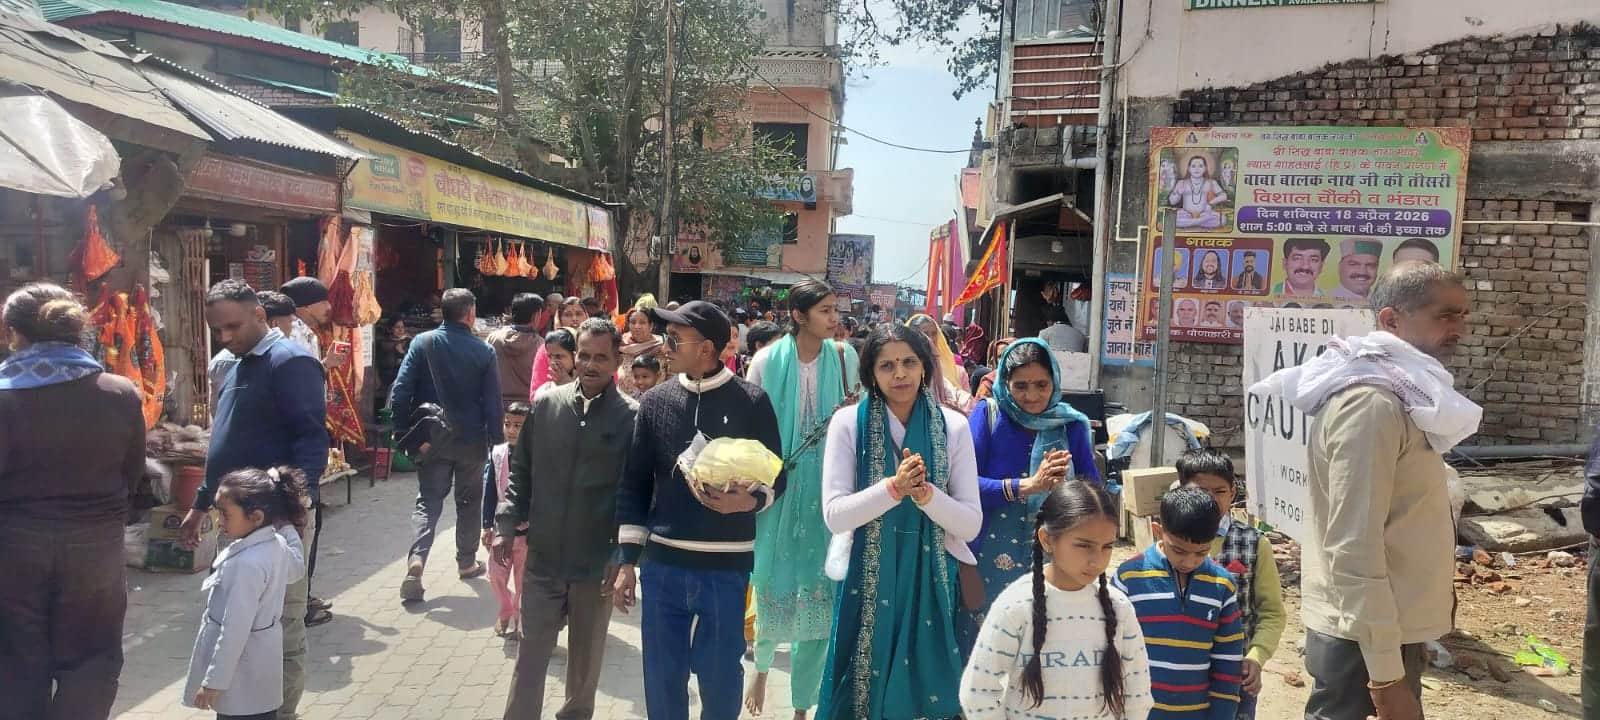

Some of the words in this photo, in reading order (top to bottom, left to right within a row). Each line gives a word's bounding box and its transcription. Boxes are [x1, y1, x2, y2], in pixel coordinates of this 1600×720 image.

[1279, 174, 1324, 187] बालक
[1359, 172, 1379, 187] जी
[1408, 172, 1452, 188] तीसरी
[1253, 188, 1311, 204] विशाल
[1367, 193, 1381, 205] व
[1386, 190, 1441, 207] भंडारा
[1256, 207, 1280, 219] दिन
[1283, 208, 1330, 220] शनिवार
[1335, 210, 1352, 220] 18
[1394, 211, 1430, 221] 2026
[1240, 222, 1264, 232] शाम
[1266, 222, 1292, 232] 5:00
[1295, 221, 1315, 233] बजे
[1317, 222, 1329, 233] से
[1331, 224, 1356, 233] बाबा
[1359, 222, 1374, 234] जी
[1424, 226, 1448, 236] तक
[1184, 237, 1235, 247] गायक
[1270, 316, 1285, 333] JAI
[1289, 317, 1316, 334] BABE
[1322, 318, 1334, 335] DI
[1106, 342, 1127, 355] जाना
